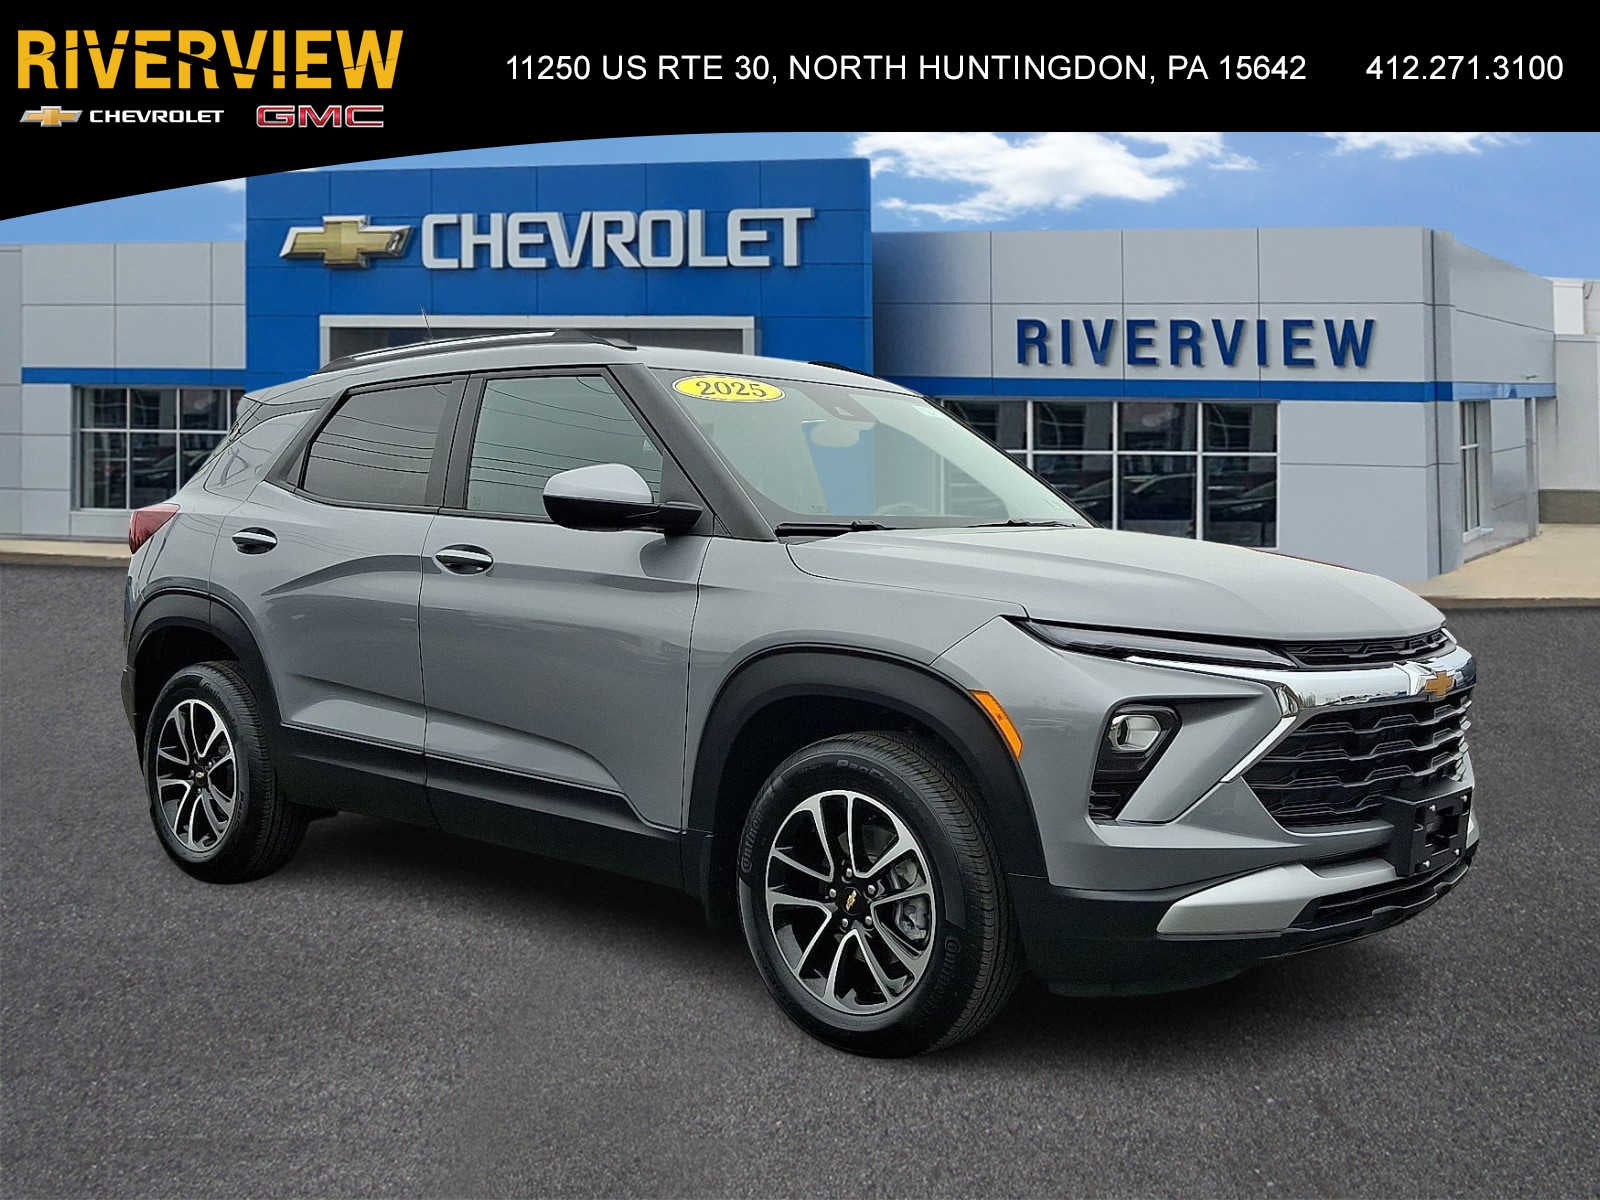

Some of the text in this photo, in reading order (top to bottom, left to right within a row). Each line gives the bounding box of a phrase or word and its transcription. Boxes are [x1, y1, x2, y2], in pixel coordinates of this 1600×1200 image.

[421, 207, 813, 270] CHEVROLET
[1016, 318, 1375, 368] RIVERVIEW
[695, 380, 767, 398] 2025
